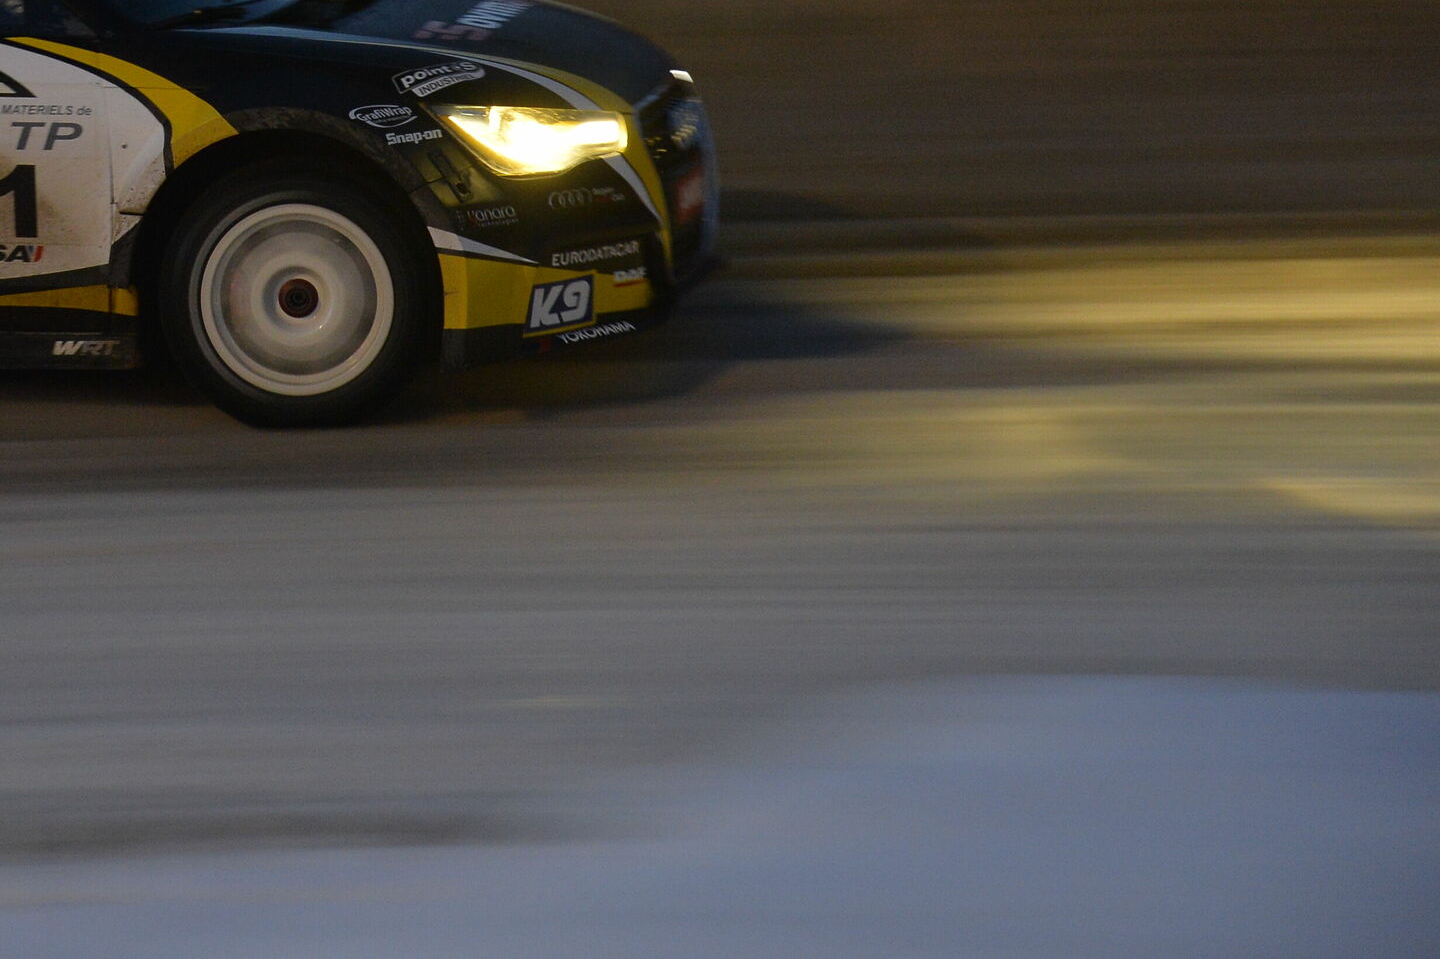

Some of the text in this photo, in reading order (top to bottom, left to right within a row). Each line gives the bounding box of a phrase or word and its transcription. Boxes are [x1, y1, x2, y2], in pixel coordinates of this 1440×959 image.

[1, 105, 73, 115] MATERIELS
[357, 105, 412, 122] GrafiWrap
[11, 122, 82, 150] TP
[385, 129, 443, 145] Snap-on
[552, 240, 639, 267] EURODATACAR
[530, 280, 591, 328] K9
[557, 320, 637, 344] YOKOHAMA
